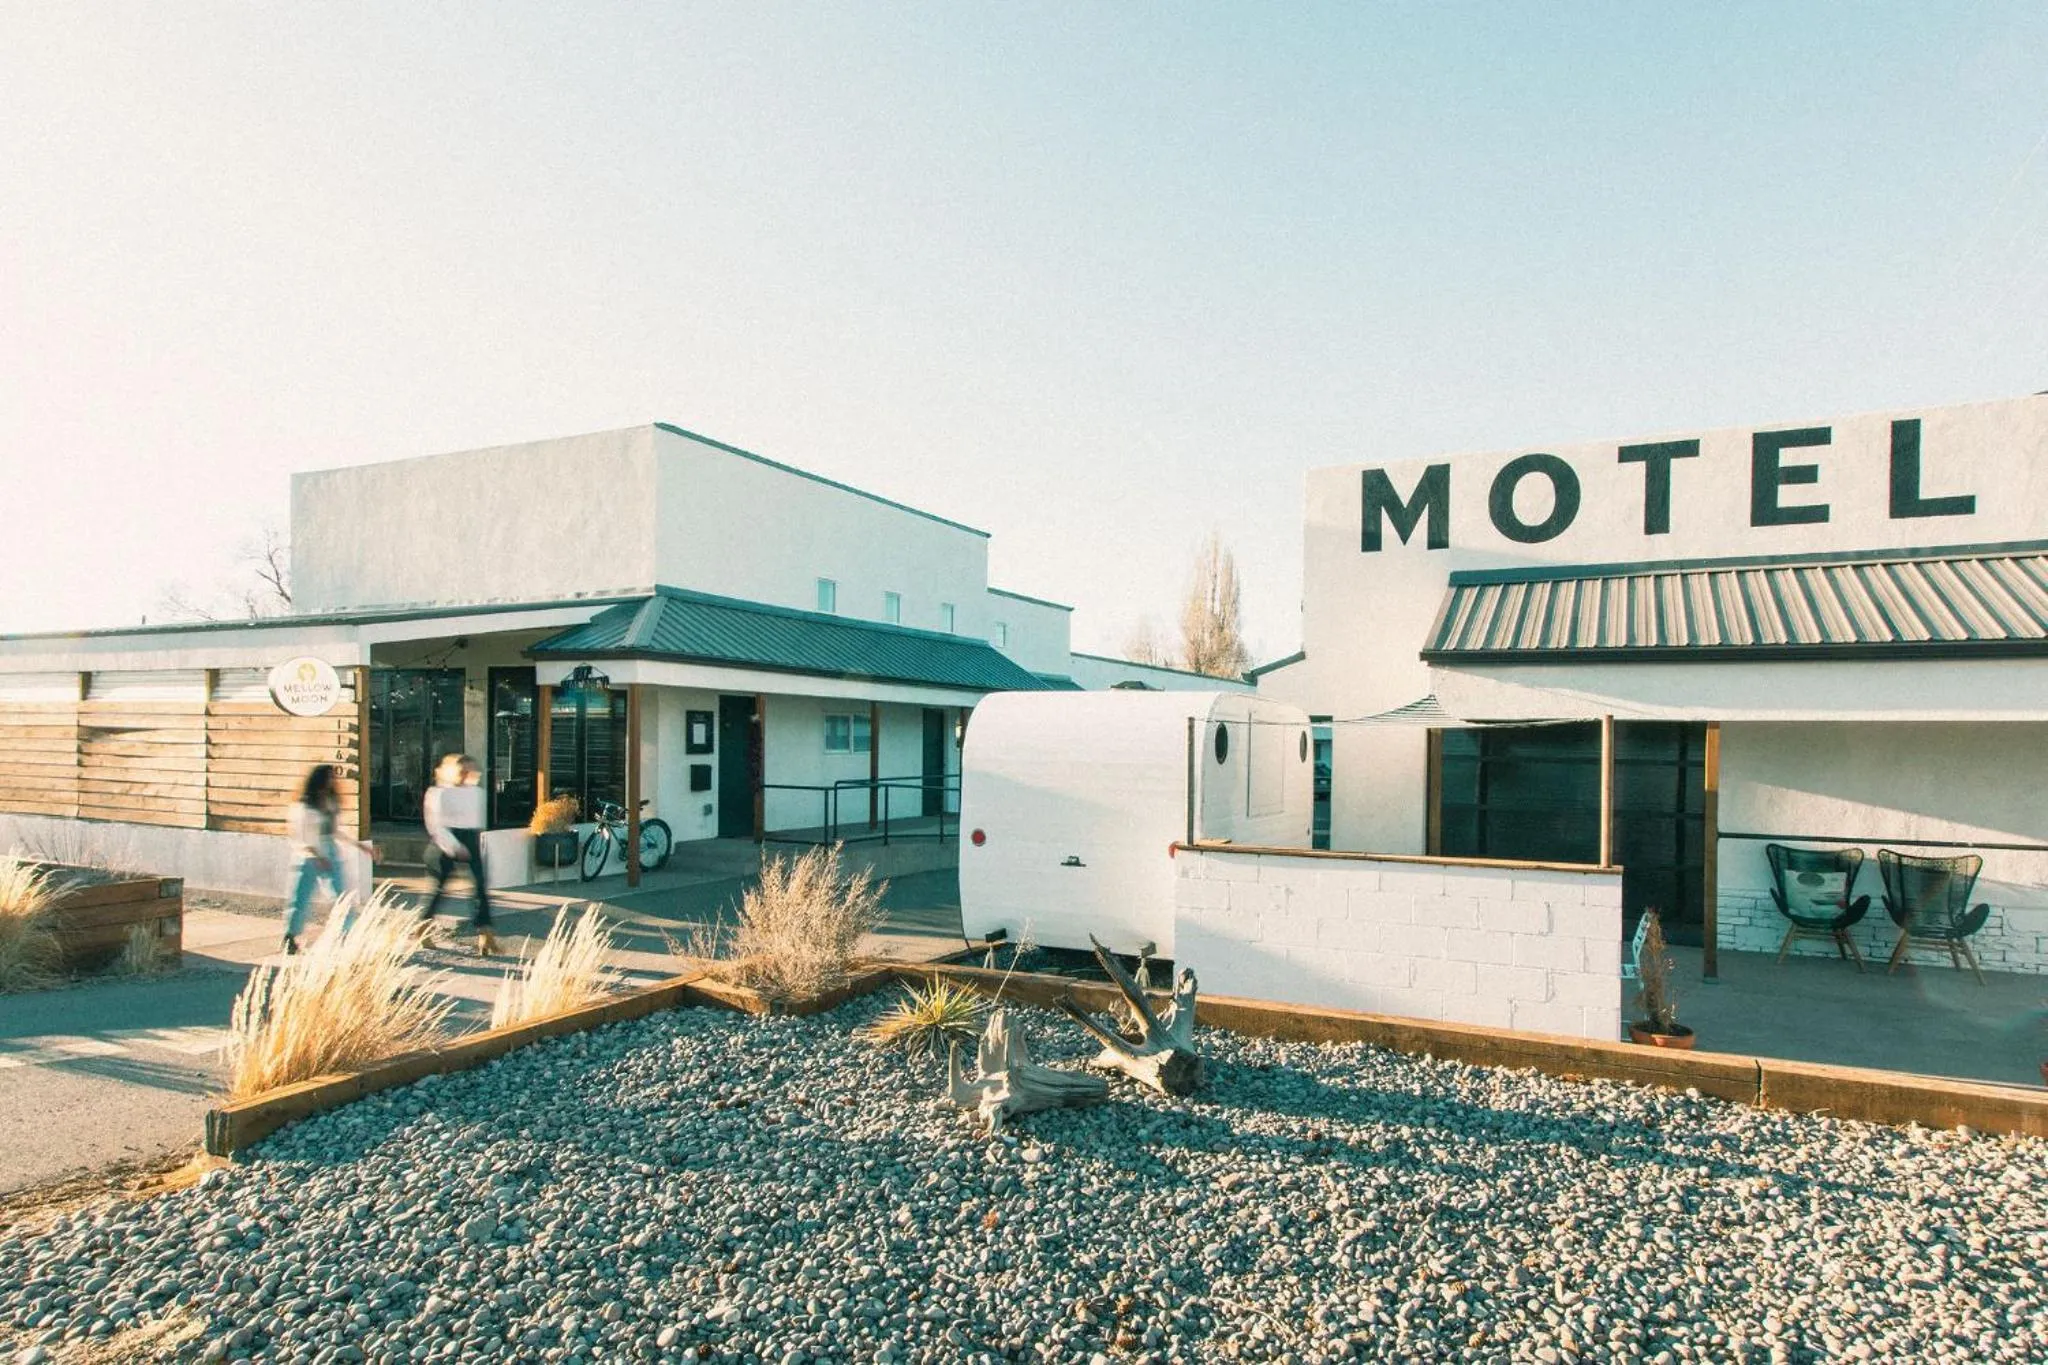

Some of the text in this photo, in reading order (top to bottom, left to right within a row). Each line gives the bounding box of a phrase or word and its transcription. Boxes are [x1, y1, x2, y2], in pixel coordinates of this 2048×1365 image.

[1362, 419, 1976, 552] MOTEL
[283, 682, 331, 693] MELLOW
[291, 695, 328, 704] MOON
